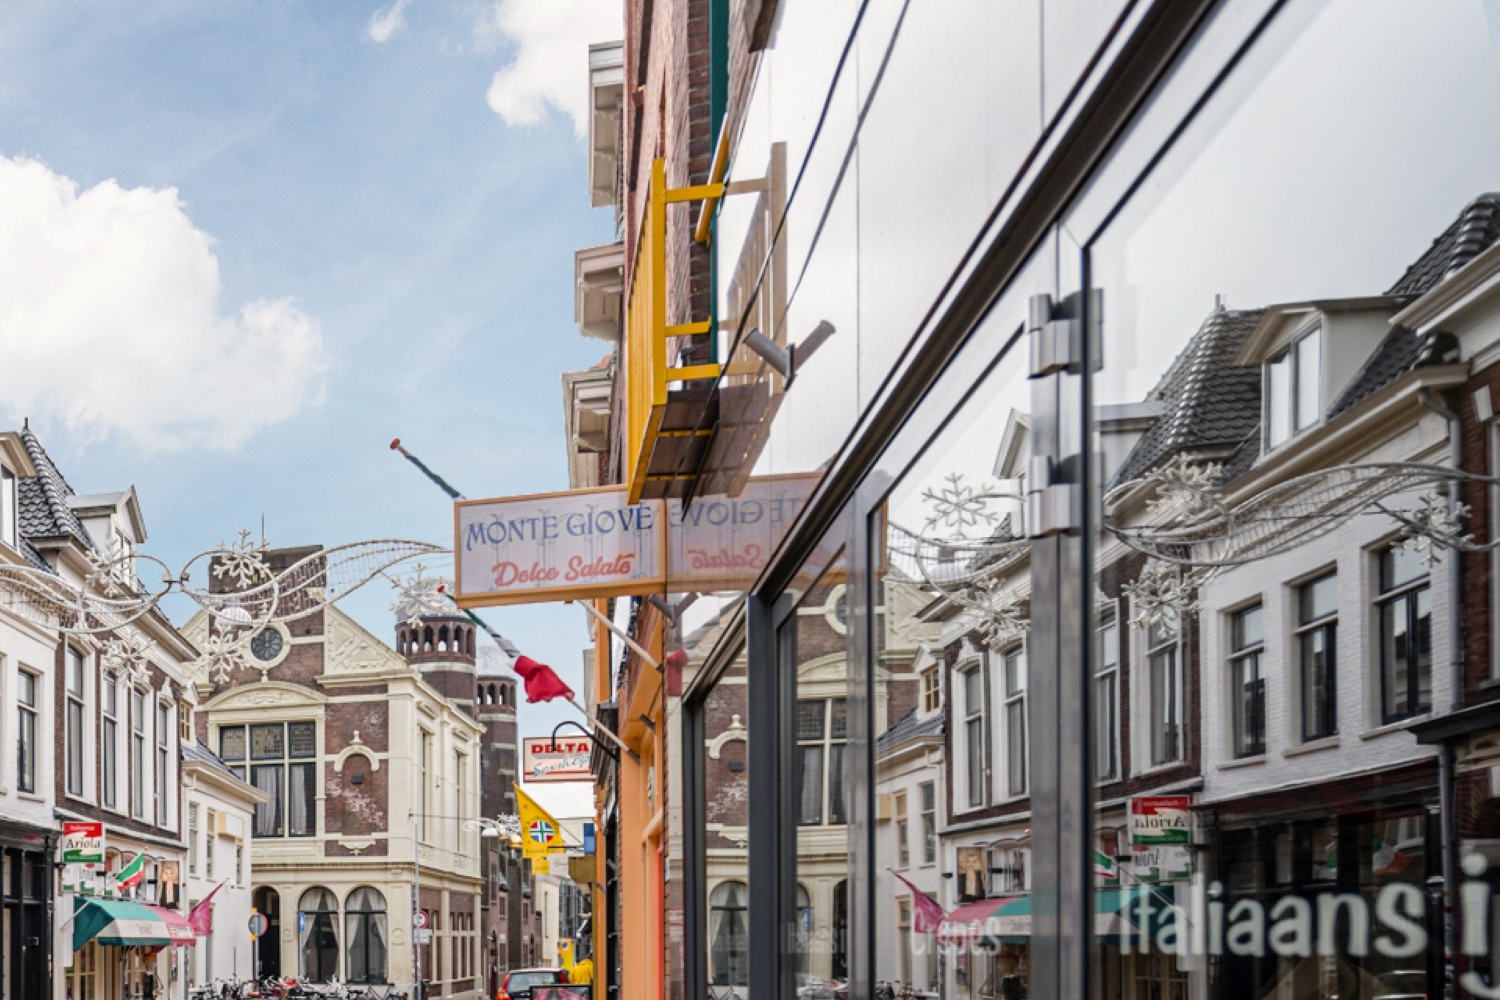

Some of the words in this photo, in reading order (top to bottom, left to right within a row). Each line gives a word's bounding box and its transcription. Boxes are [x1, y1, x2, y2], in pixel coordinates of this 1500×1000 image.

[466, 514, 559, 551] MONTE
[566, 504, 655, 536] GIOVE
[491, 561, 559, 587] Dolce
[564, 553, 636, 582] Salato
[531, 742, 589, 753] DELTA
[66, 836, 101, 849] Ariola
[1119, 871, 1428, 958] Italiaans
